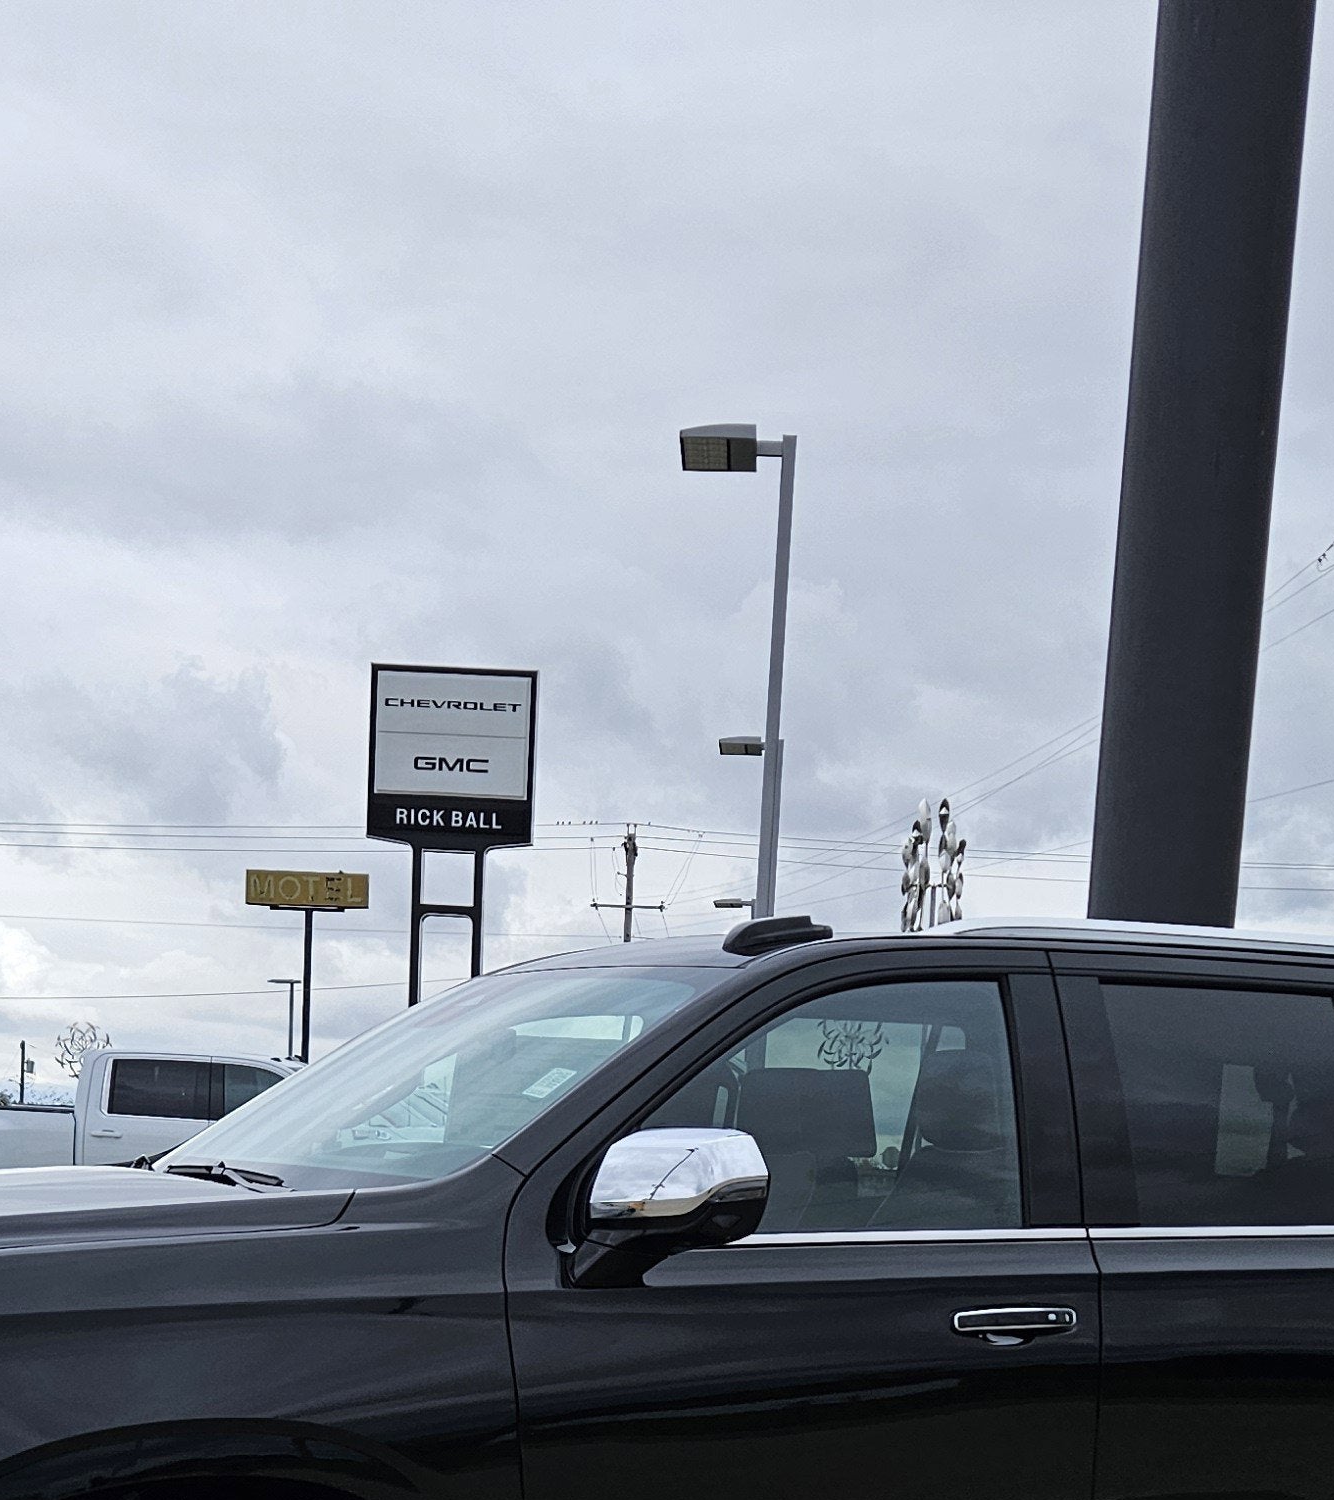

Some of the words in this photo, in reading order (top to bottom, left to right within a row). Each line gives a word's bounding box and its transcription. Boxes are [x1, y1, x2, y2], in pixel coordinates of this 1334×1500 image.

[384, 697, 522, 713] CHEVROLET
[413, 756, 490, 774] GMC
[395, 807, 445, 827] RICK
[451, 810, 502, 830] BALL
[250, 873, 362, 902] MOTEL
